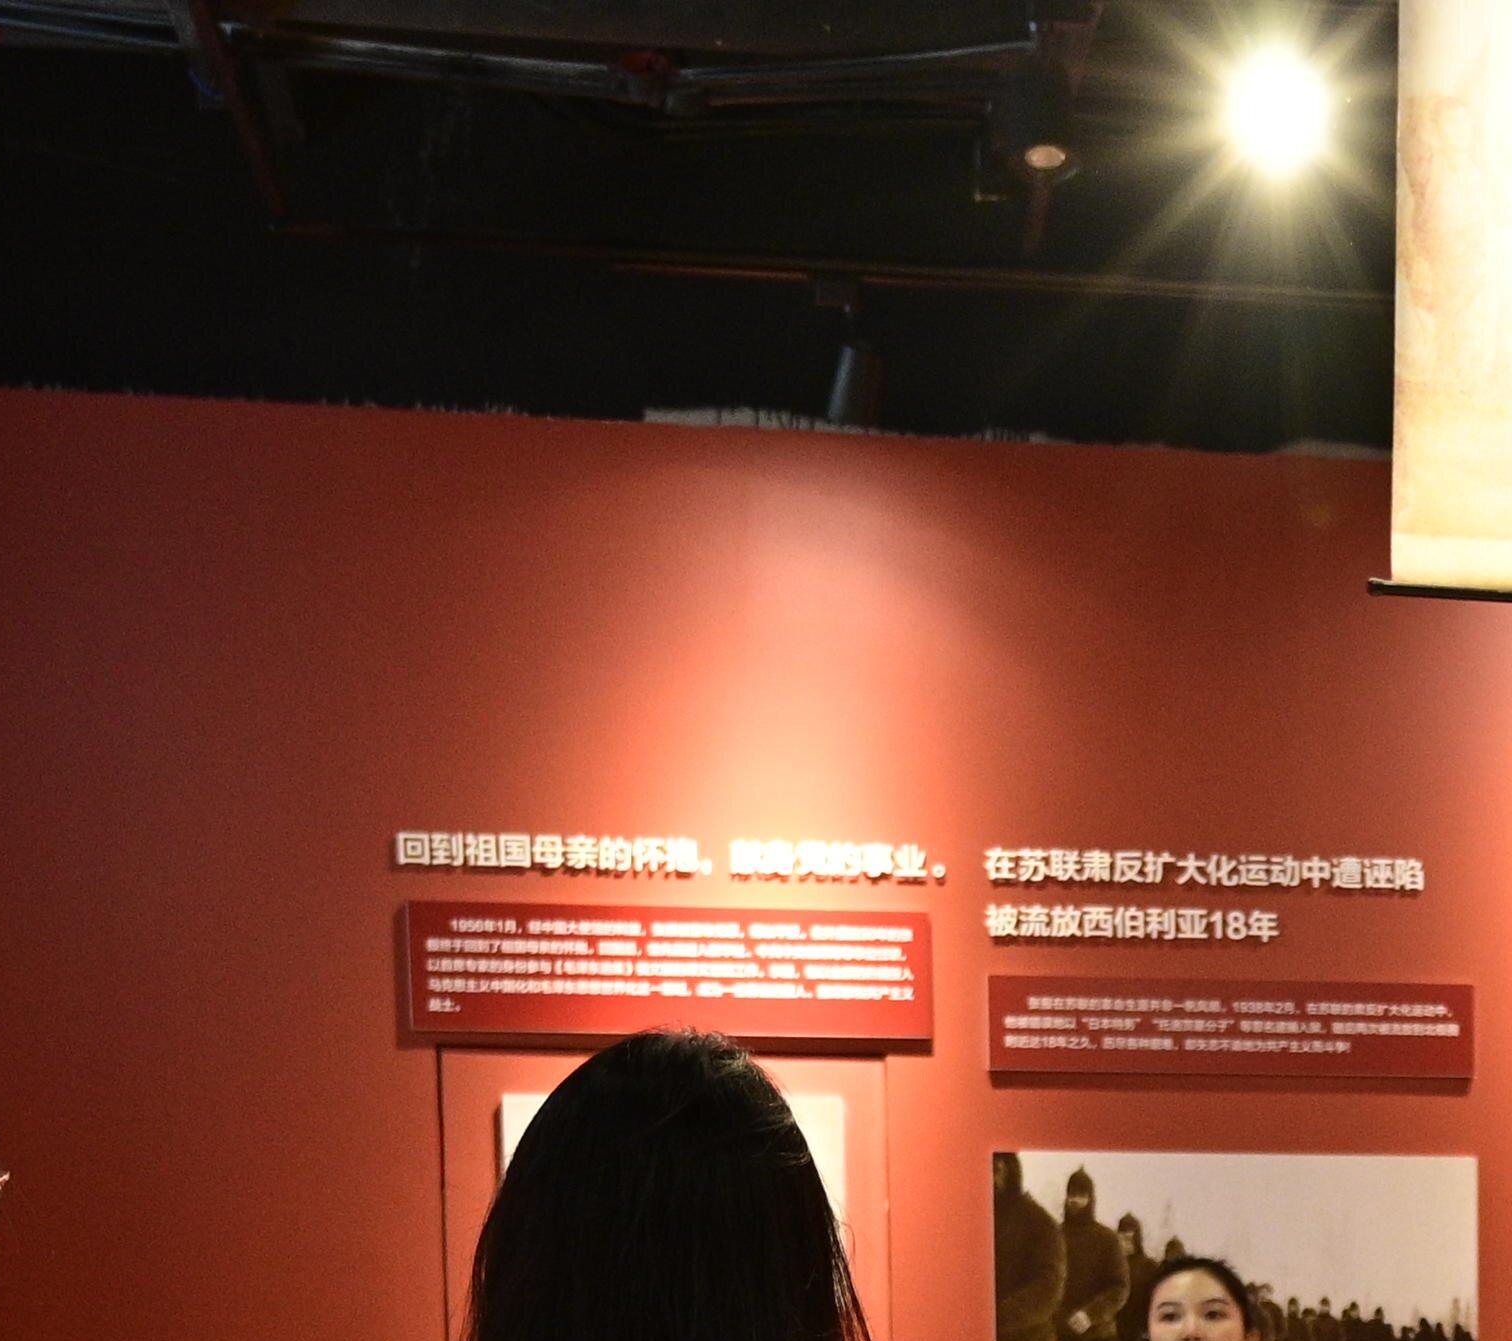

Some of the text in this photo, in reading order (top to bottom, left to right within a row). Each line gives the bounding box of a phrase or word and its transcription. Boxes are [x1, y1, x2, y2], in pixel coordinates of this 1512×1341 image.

[984, 848, 1424, 892] 在苏联肃反扩大化运动中遭诬陷
[985, 904, 1279, 943] 被流放西伯利亚18年
